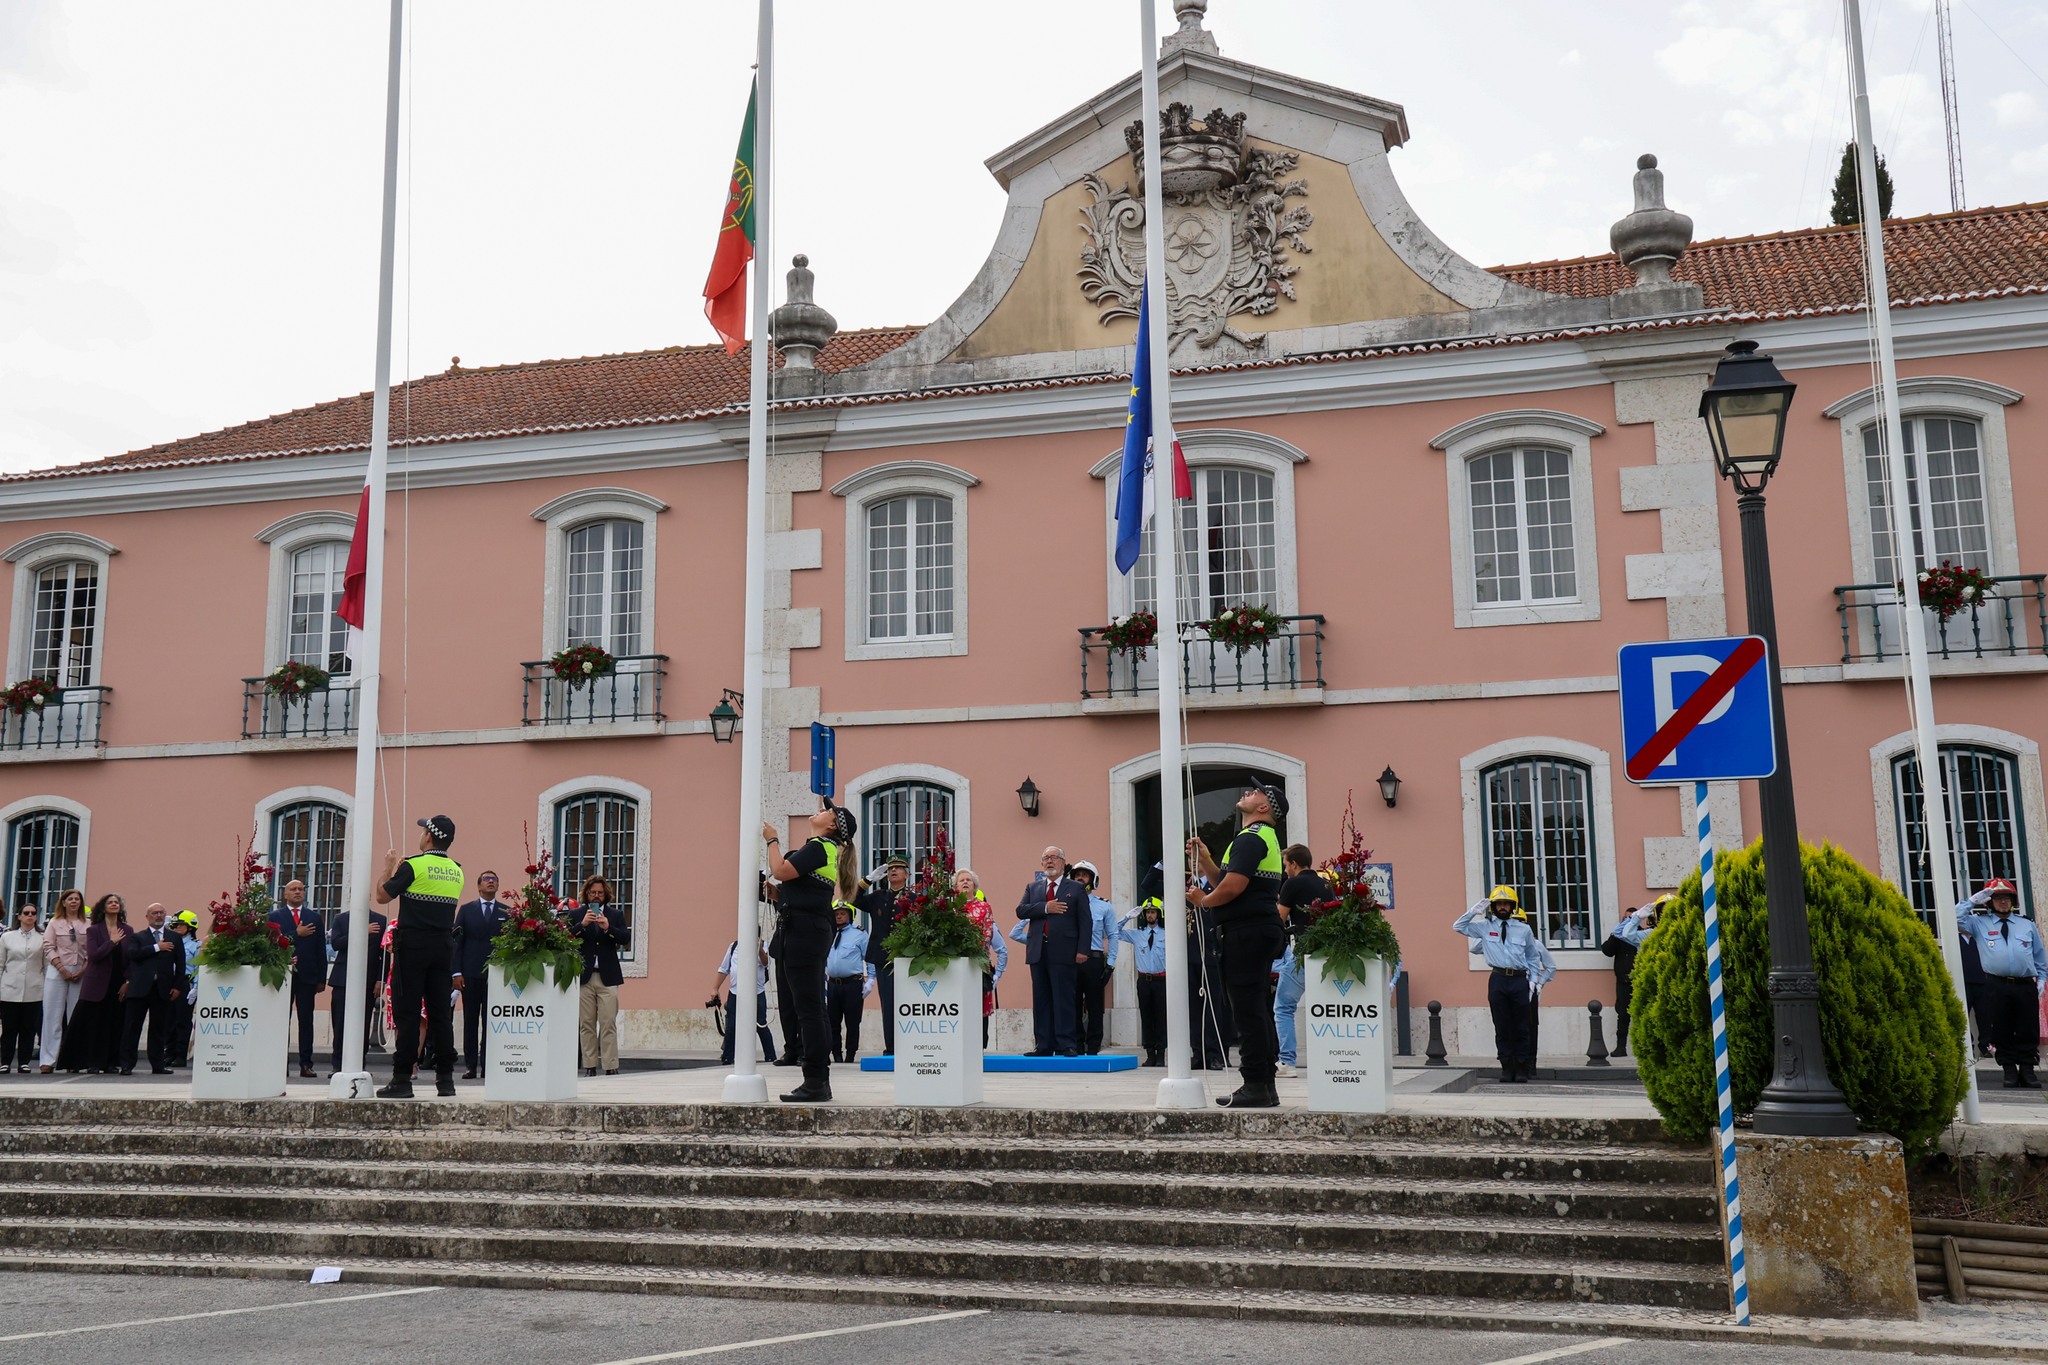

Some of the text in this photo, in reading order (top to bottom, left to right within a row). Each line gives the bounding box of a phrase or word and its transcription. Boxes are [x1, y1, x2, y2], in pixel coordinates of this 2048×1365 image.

[1651, 654, 1735, 767] P
[427, 865, 461, 877] POLÍCIA
[428, 874, 460, 884] MUNICIPAL
[200, 1007, 248, 1019] OEIRAS
[491, 1005, 544, 1017] OEIRAS
[899, 1003, 959, 1016] OEIRAS
[1311, 1004, 1378, 1018] OEIRAS
[199, 1022, 249, 1035] VALLEY
[491, 1021, 544, 1034] VALLEY
[898, 1020, 959, 1034] VALLEY
[1311, 1023, 1378, 1038] VALLEY
